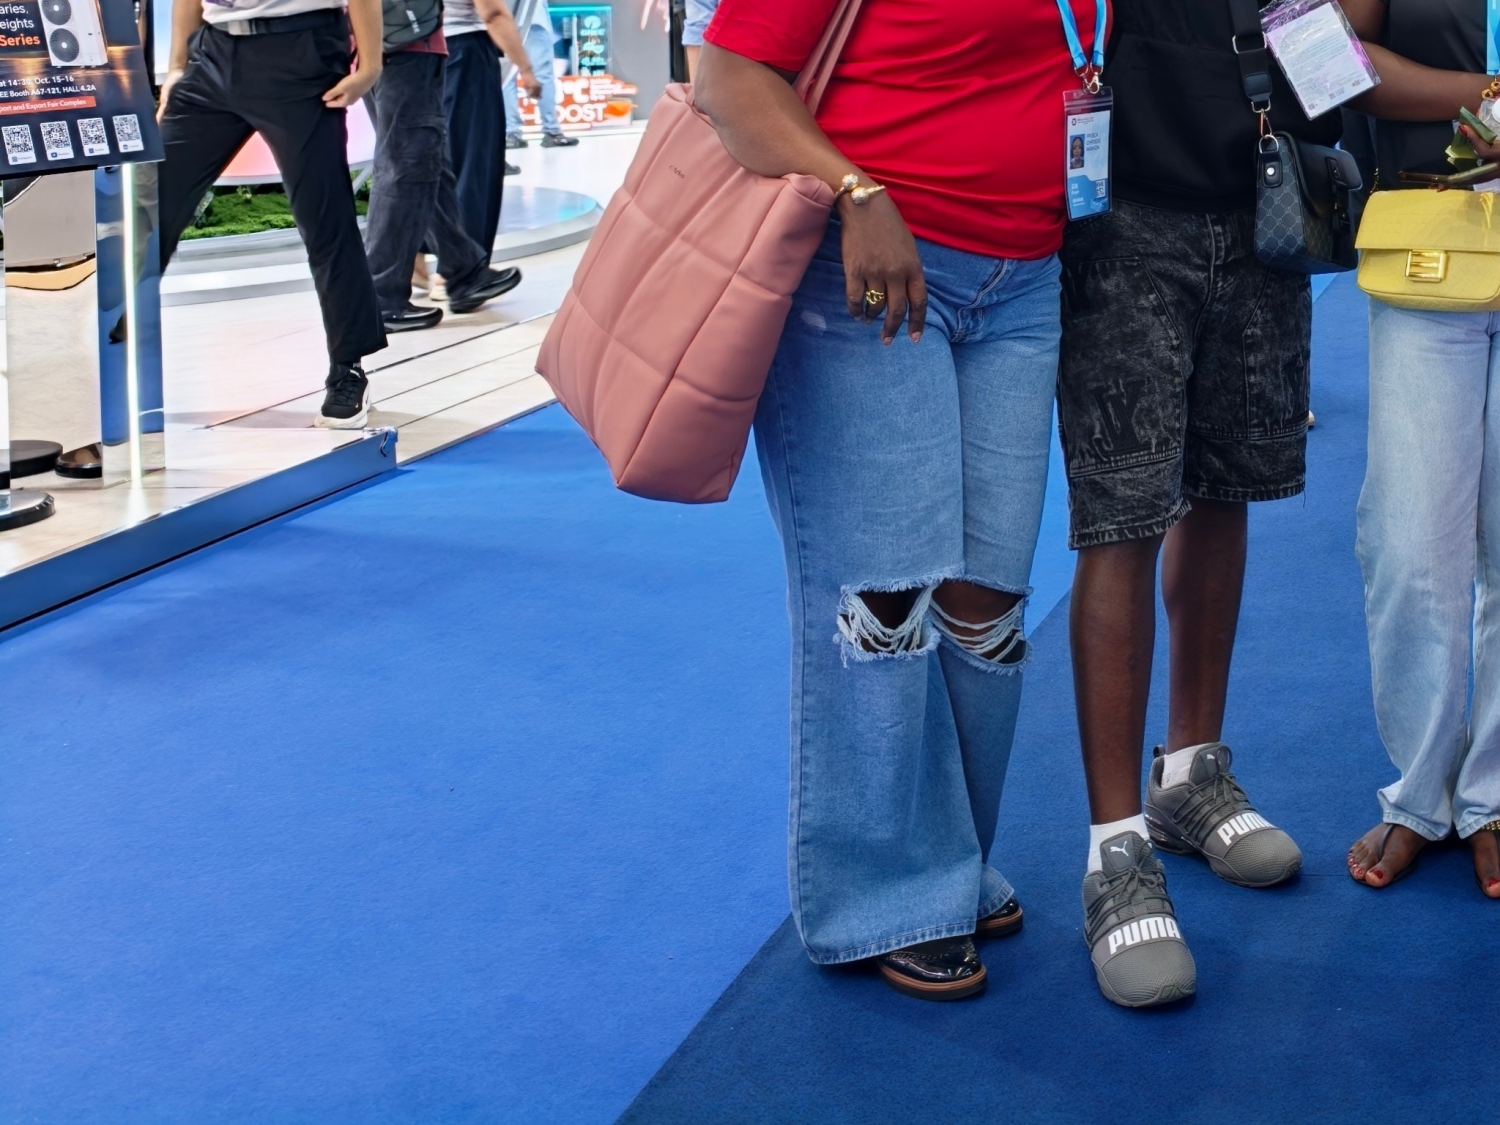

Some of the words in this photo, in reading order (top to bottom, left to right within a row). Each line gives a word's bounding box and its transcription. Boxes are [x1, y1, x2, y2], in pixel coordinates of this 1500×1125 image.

[0, 34, 41, 47] Series
[10, 88, 30, 97] Booth
[12, 103, 26, 111] and
[26, 101, 47, 111] Export
[1107, 916, 1181, 955] PUMA
